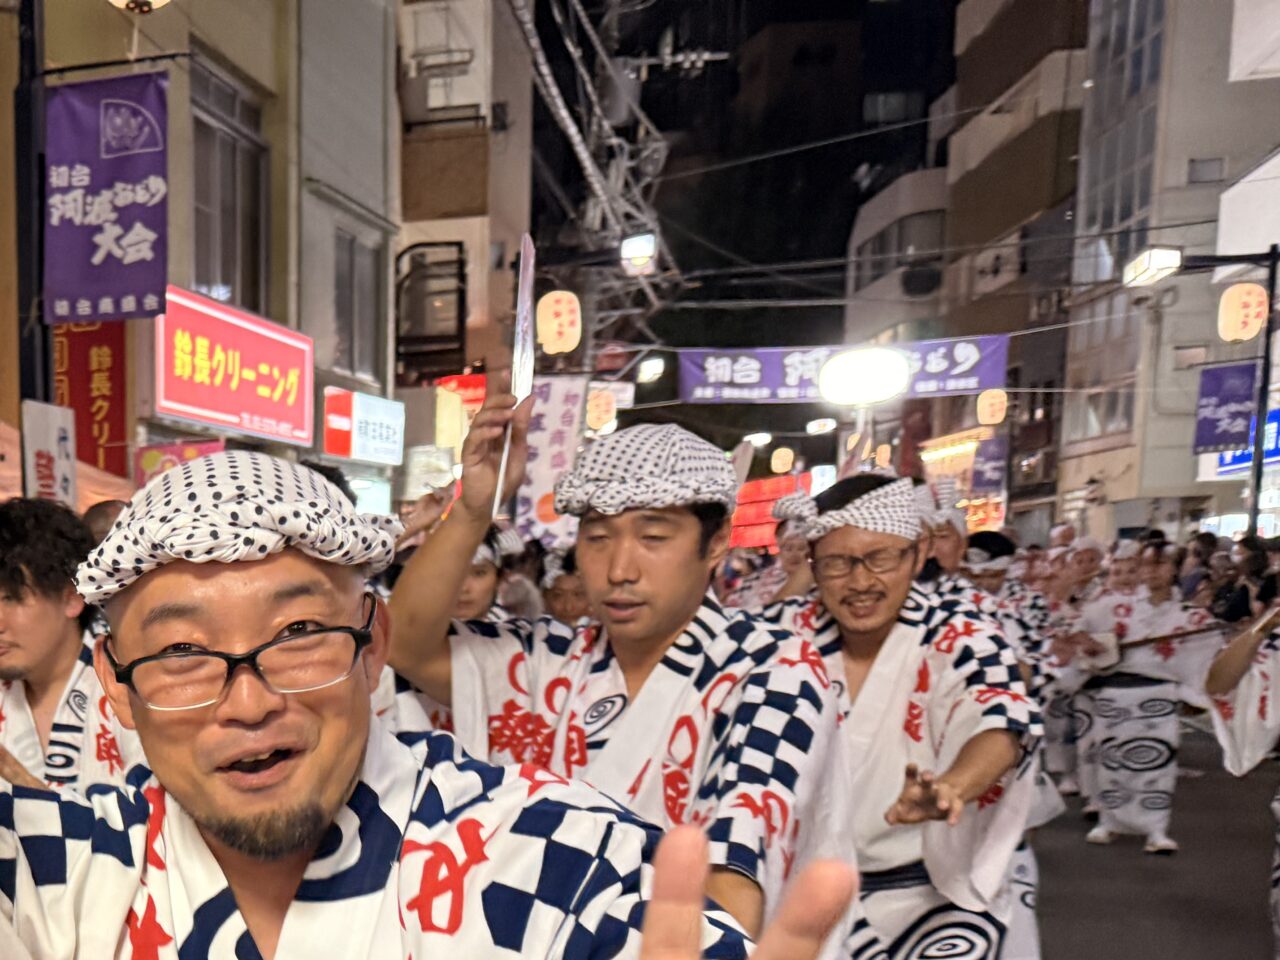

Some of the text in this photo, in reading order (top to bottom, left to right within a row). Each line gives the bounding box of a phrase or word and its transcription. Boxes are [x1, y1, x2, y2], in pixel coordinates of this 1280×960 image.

[90, 222, 159, 266] 大会
[174, 328, 301, 406] 鈴長クリーニング
